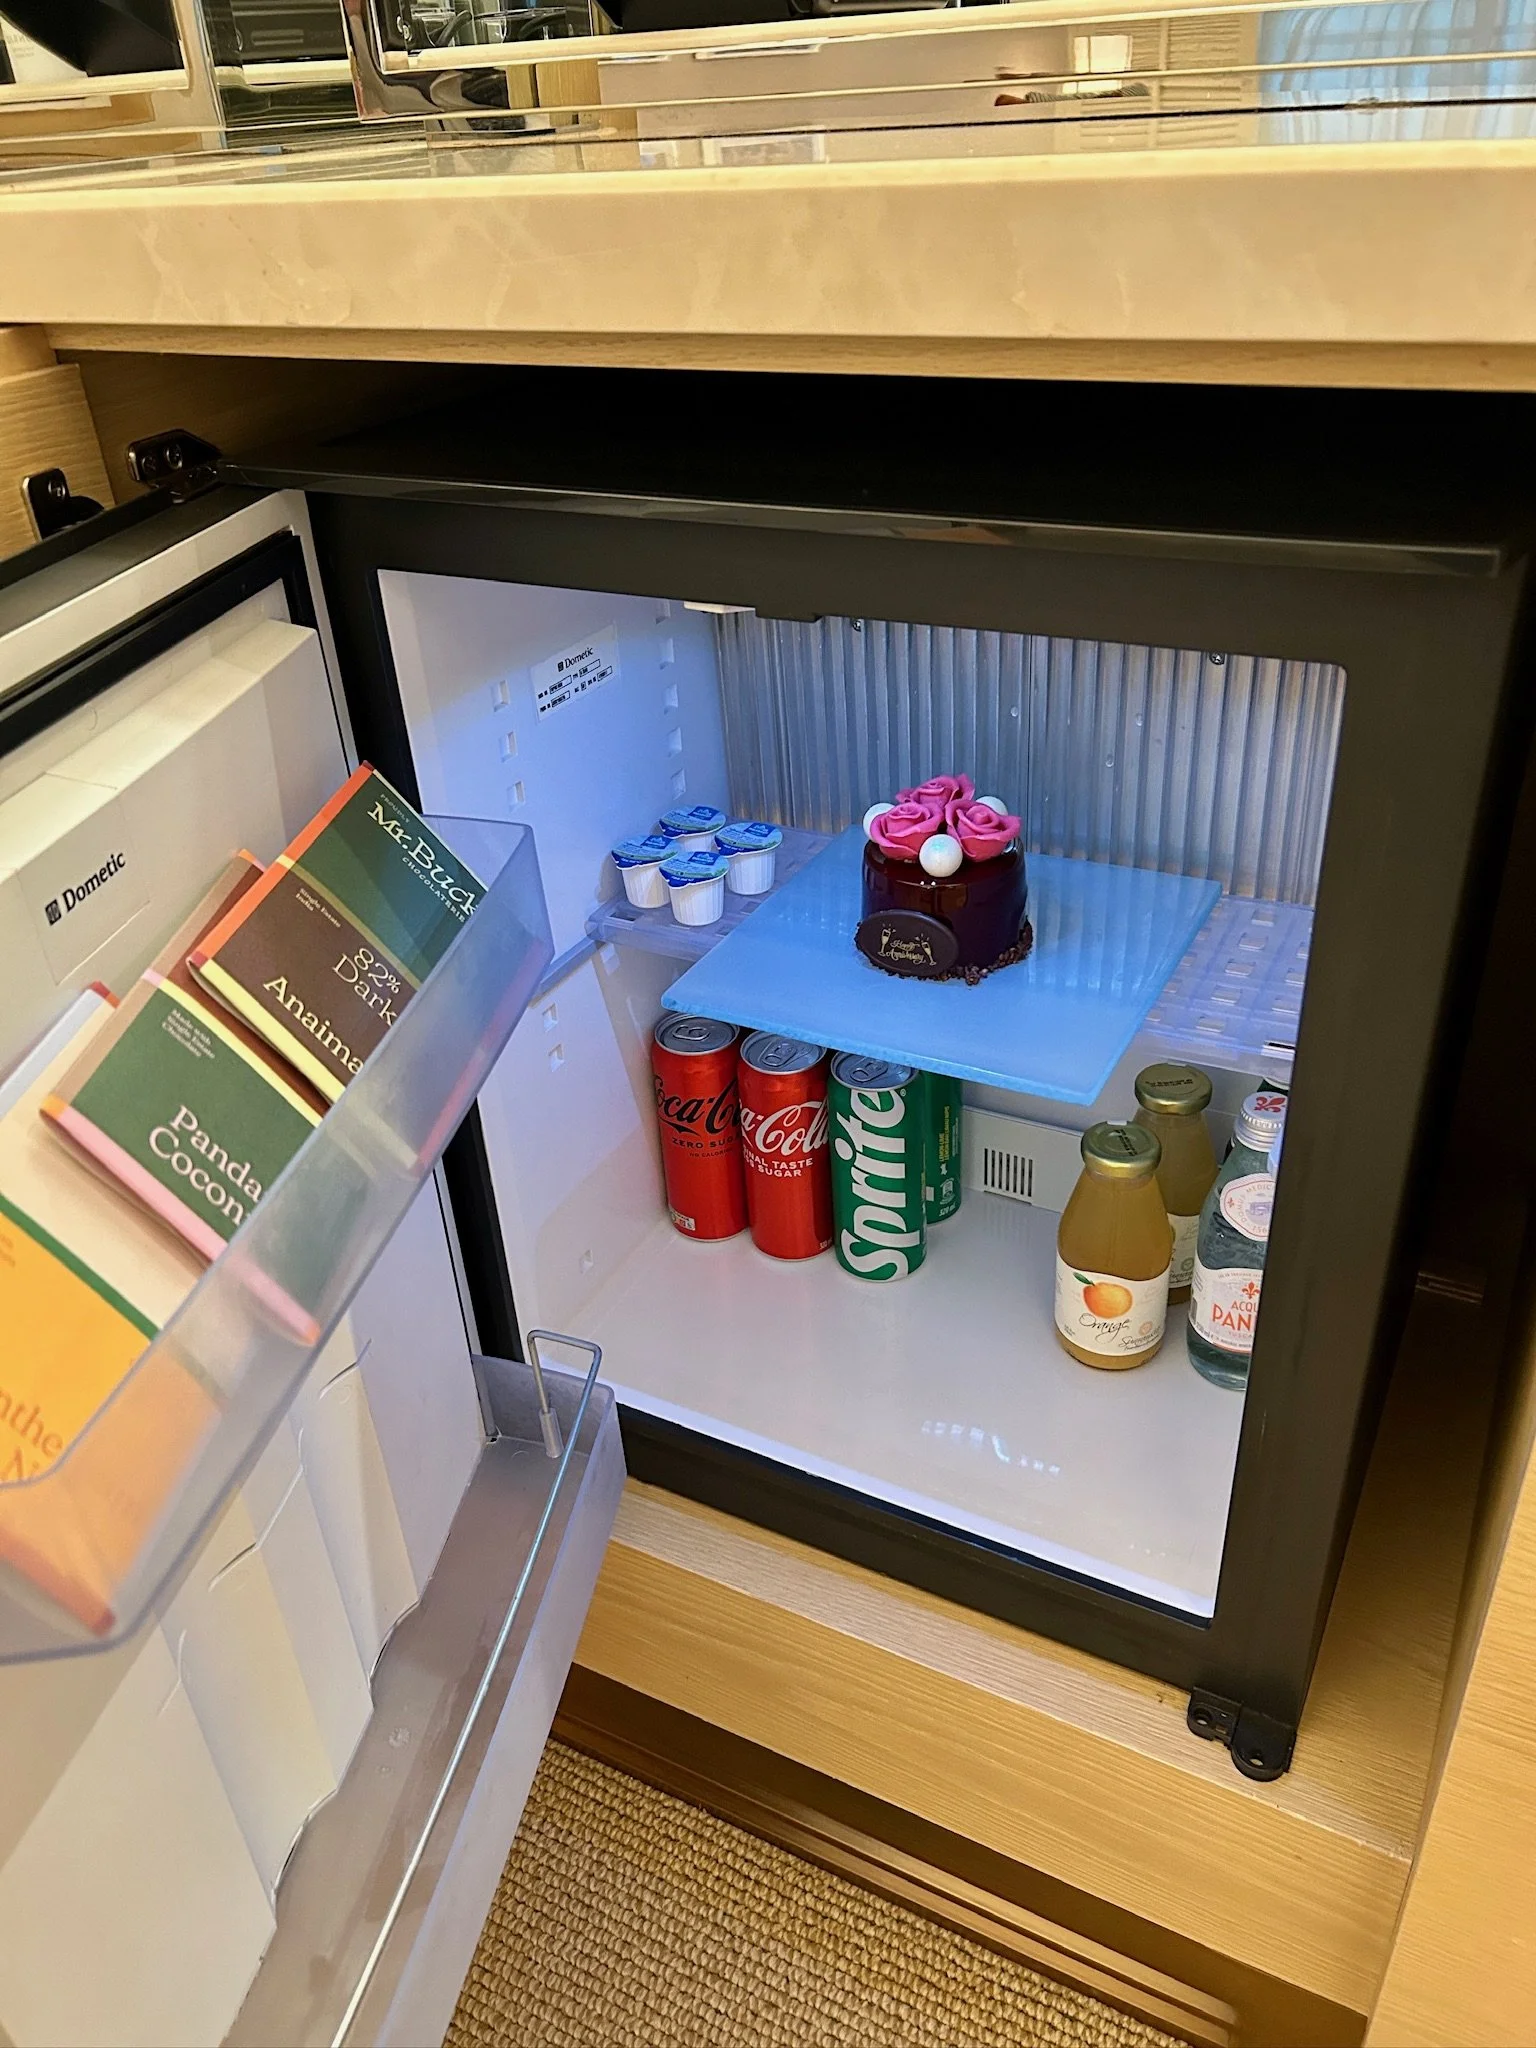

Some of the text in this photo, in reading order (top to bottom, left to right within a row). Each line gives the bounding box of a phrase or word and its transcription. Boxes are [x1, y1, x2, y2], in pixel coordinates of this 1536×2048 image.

[564, 647, 594, 668] Dometic
[62, 852, 126, 914] Dometic
[402, 857, 466, 923] CHOCOLATERIE
[353, 947, 401, 994] 82%
[333, 953, 398, 1027] Dark
[169, 1105, 263, 1203] Panda
[671, 1135, 734, 1149] ZERO SUG
[149, 1126, 247, 1227] Cocon
[758, 1164, 802, 1178] SUGAR
[771, 1157, 814, 1170] TASTE
[835, 1089, 920, 1283] Sprite
[1246, 1184, 1272, 1193] MEDIC
[1212, 1303, 1253, 1332] PAN
[1231, 1301, 1257, 1312] ACQ
[1079, 1312, 1130, 1345] Orange
